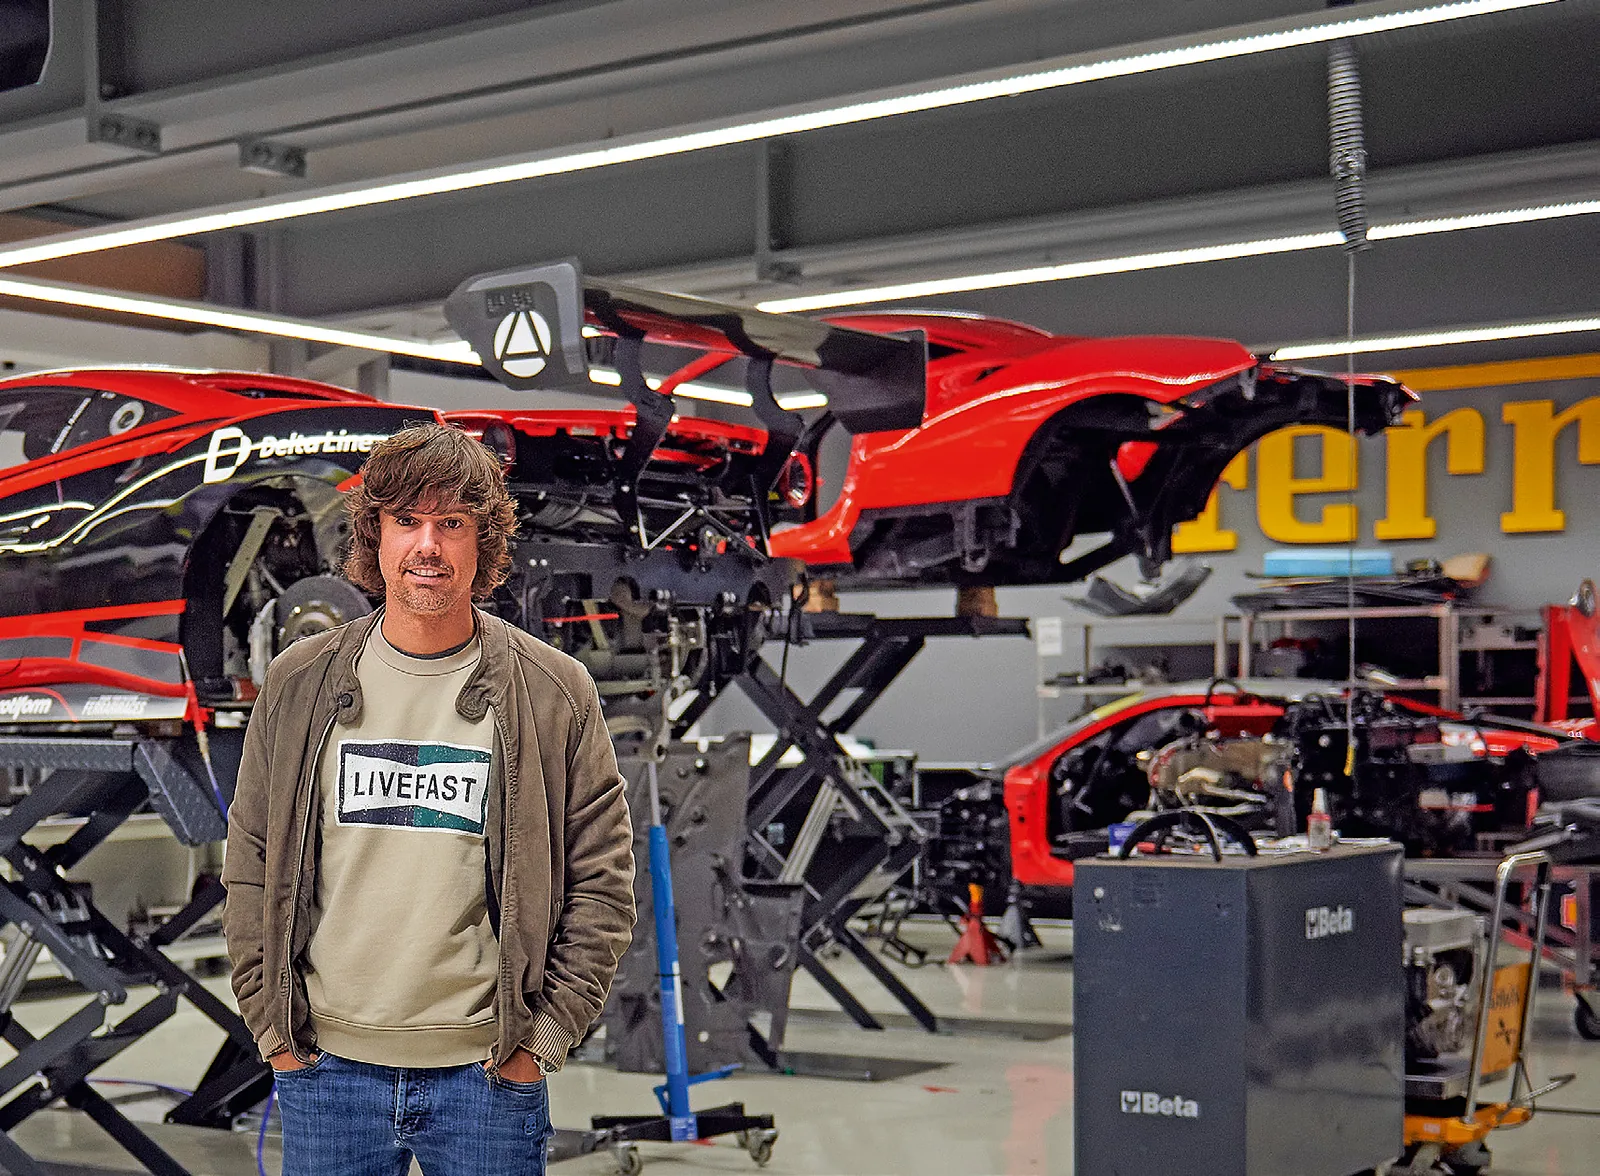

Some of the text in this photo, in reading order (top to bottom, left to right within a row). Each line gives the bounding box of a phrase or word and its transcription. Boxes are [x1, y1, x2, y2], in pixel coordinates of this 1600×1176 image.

[259, 429, 373, 459] Delta Line
[0, 695, 53, 720] otiform
[353, 770, 477, 803] LIVEFAST
[1320, 904, 1353, 937] Beta
[1142, 1091, 1199, 1118] Beta
